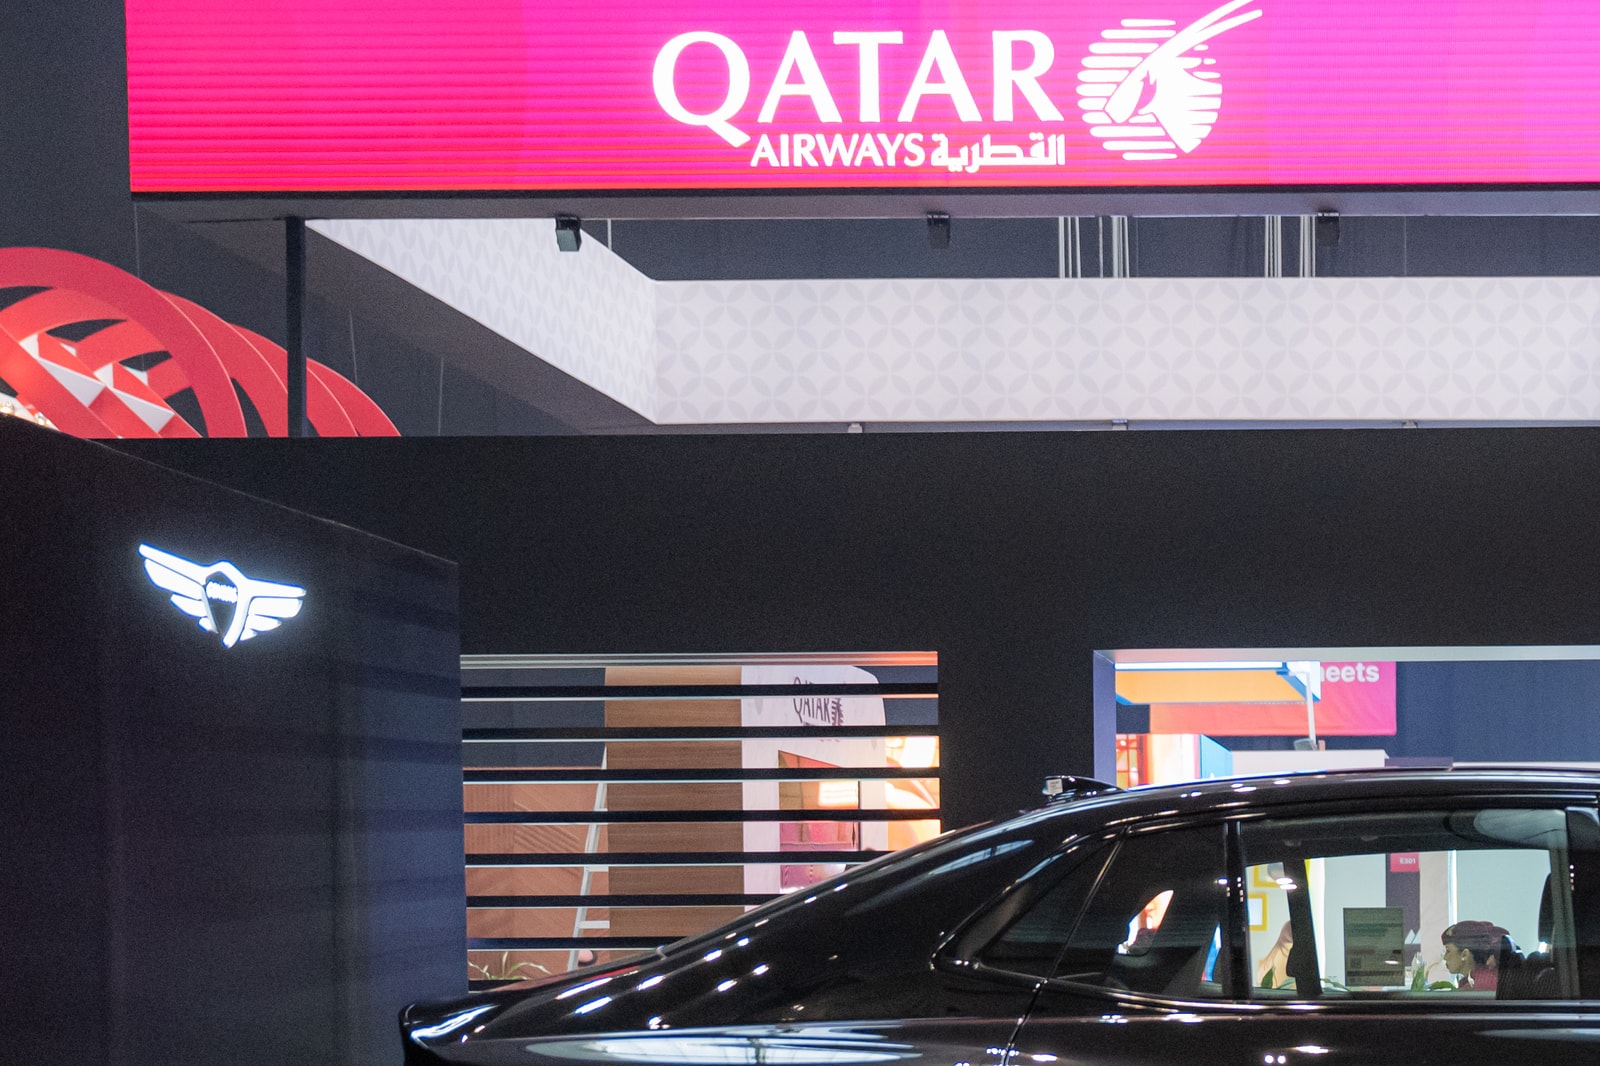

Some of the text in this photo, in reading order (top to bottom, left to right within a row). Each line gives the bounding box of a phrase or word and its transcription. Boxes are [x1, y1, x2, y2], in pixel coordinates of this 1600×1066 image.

[652, 29, 1065, 148] QATAR
[750, 132, 925, 168] AIRWAYS
[930, 131, 1066, 174] القطرية
